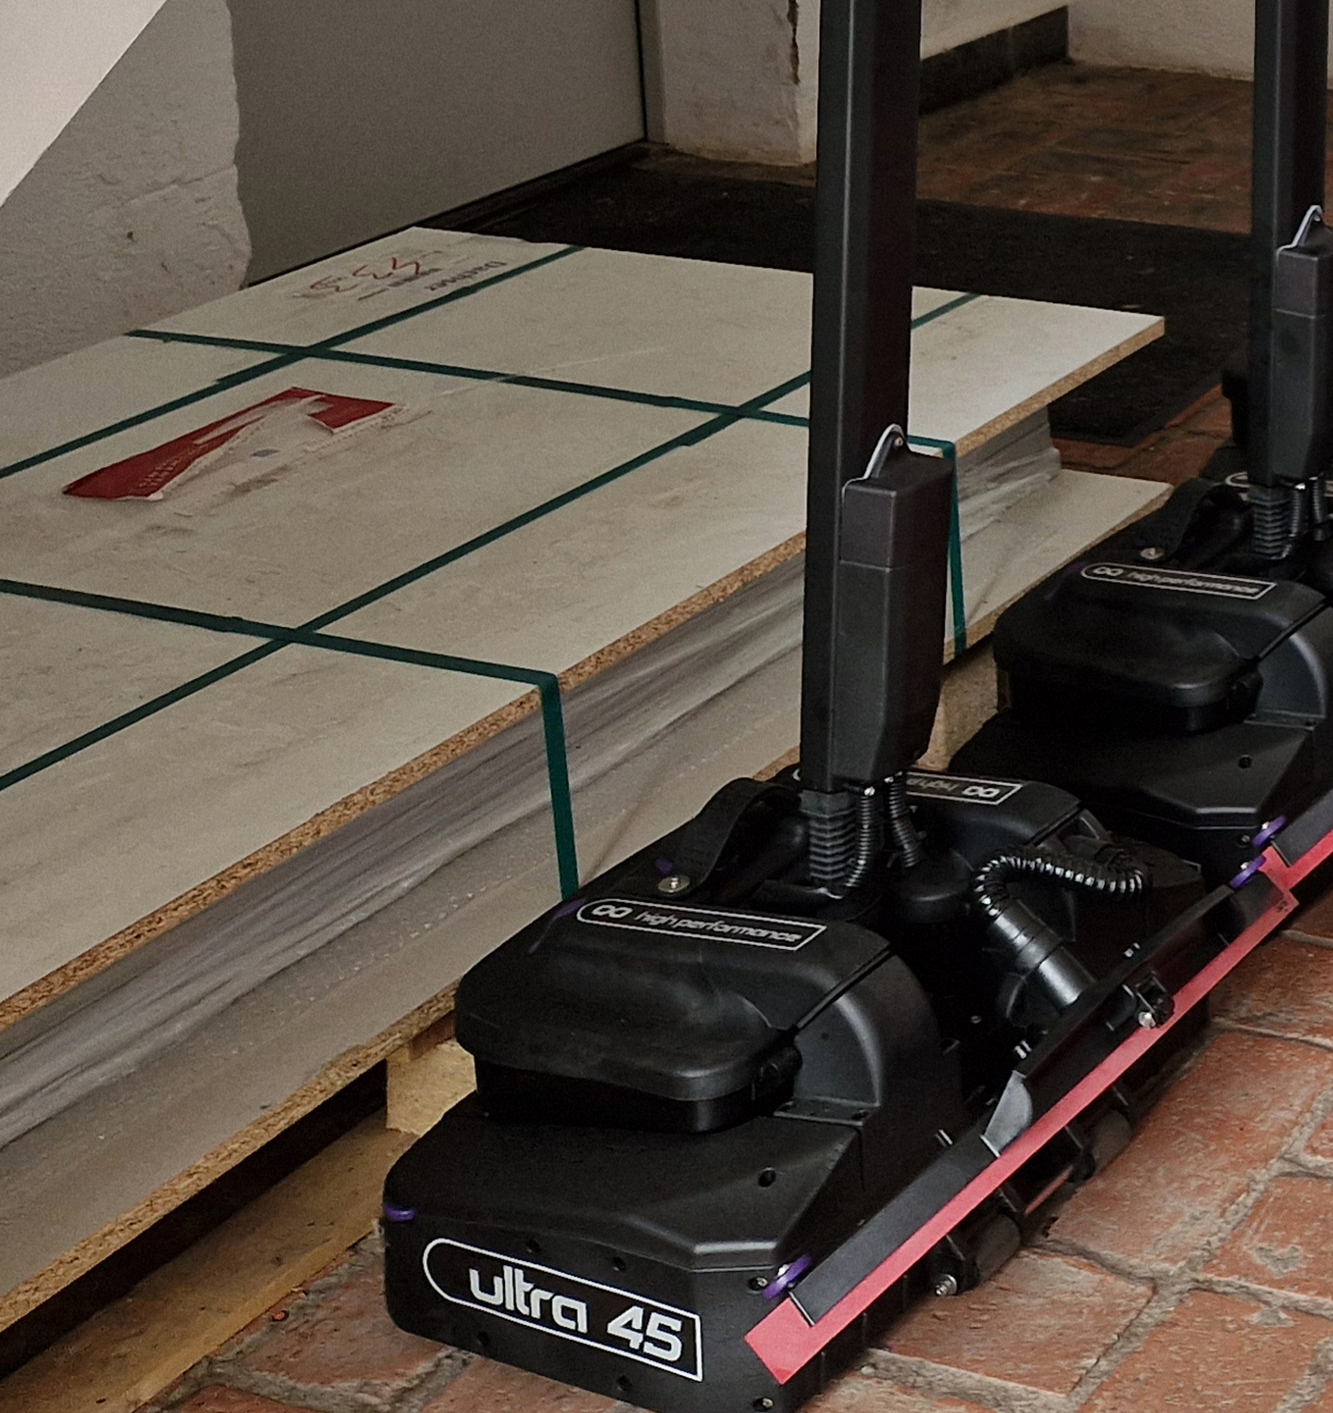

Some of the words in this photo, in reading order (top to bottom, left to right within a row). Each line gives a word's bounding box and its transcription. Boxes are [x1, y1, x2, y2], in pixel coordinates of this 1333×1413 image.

[634, 911, 679, 925] high
[672, 919, 802, 942] performance
[468, 1264, 588, 1334] ultra
[606, 1306, 683, 1362] 45
